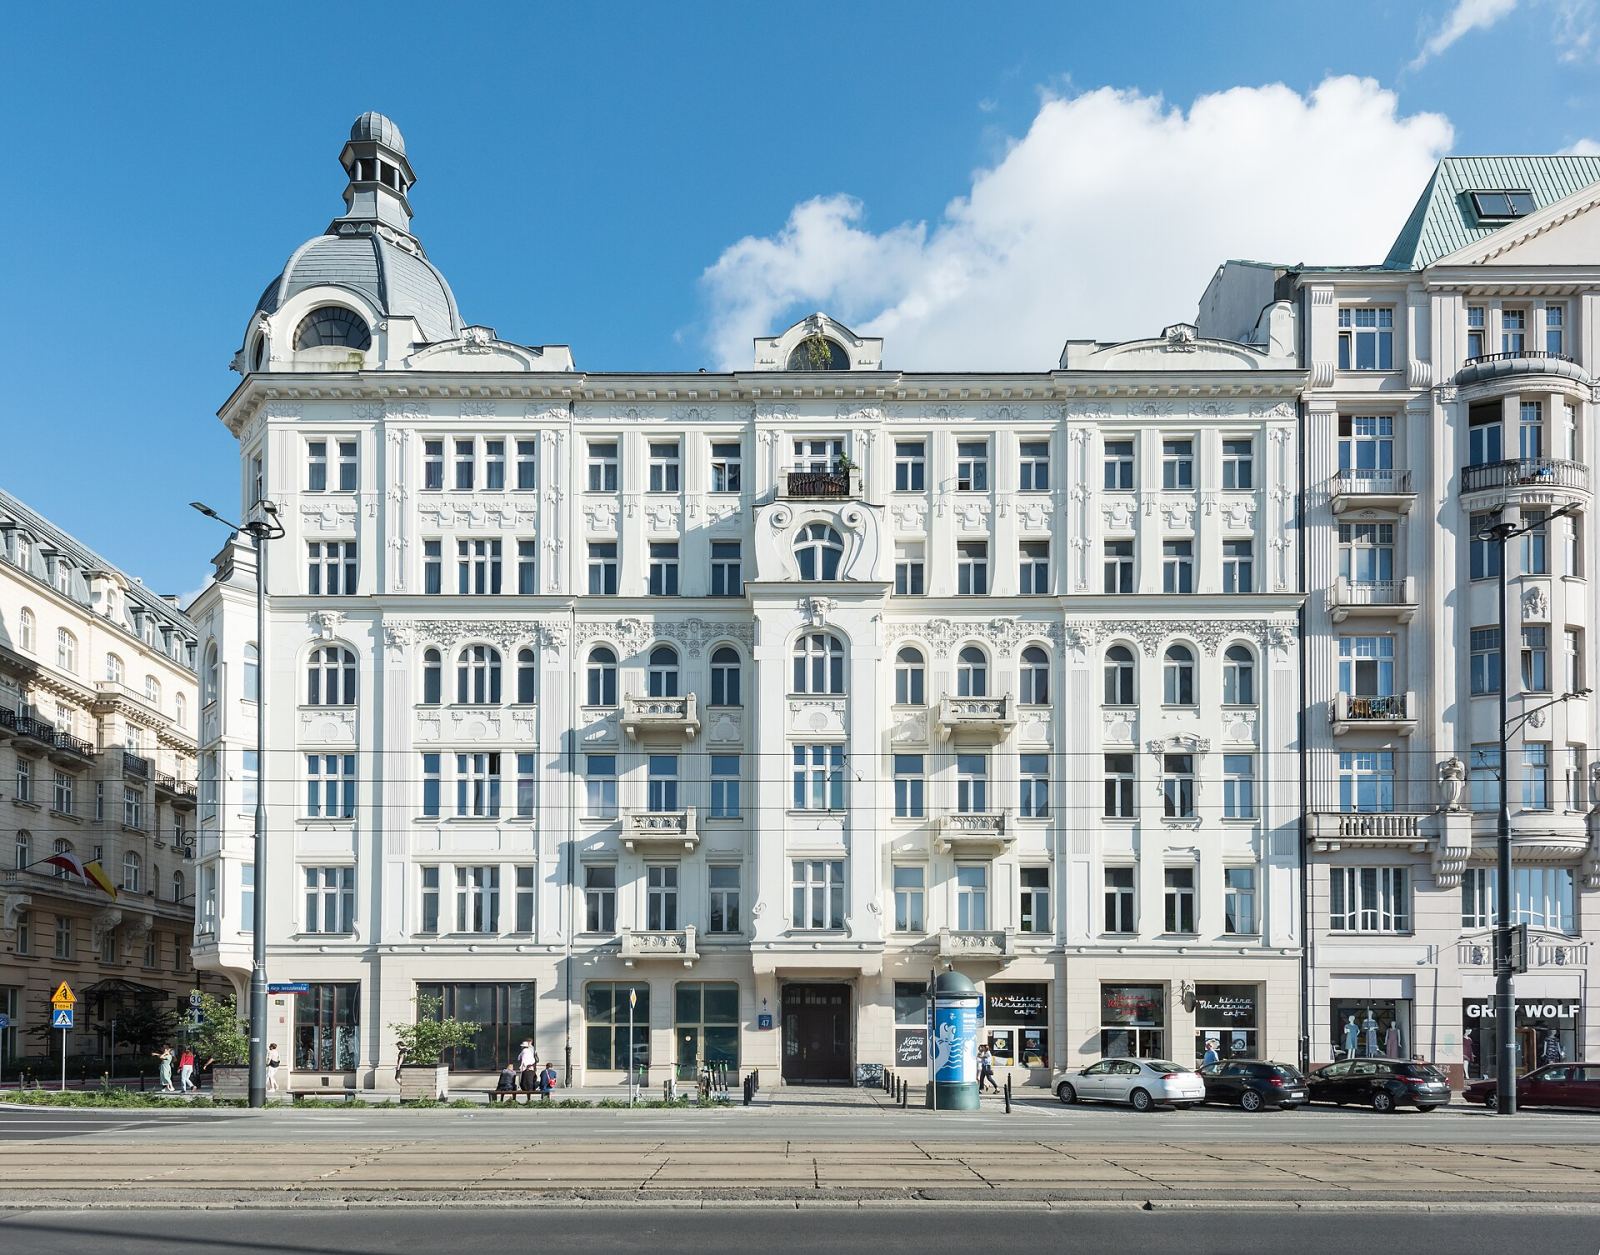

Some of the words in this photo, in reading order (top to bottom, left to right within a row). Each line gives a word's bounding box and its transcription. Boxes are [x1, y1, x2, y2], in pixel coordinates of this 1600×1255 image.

[991, 997, 1043, 1009] Warszawa
[1198, 1000, 1253, 1009] Warszawa
[1524, 1004, 1580, 1018] WOLF
[901, 1050, 922, 1062] Lunch
